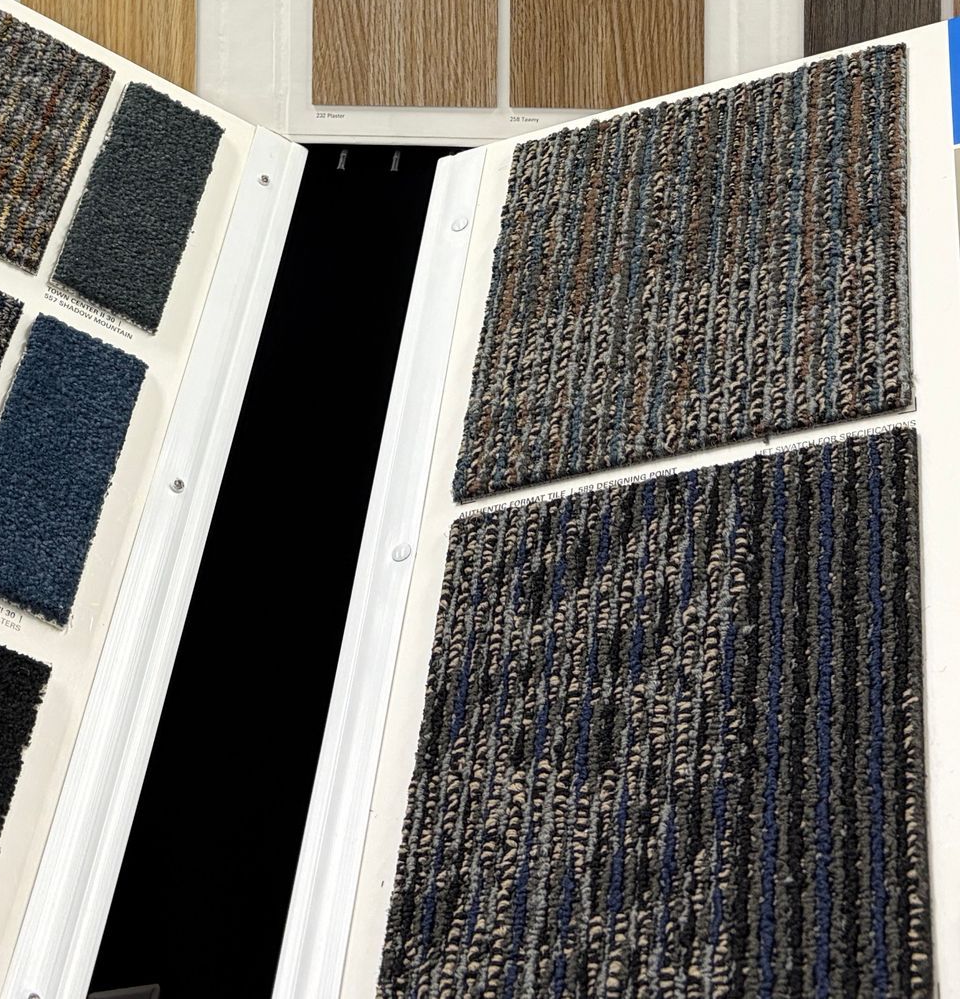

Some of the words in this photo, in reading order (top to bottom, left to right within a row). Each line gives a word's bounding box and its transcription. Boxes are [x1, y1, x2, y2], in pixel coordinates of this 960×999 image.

[44, 293, 58, 303] 557
[59, 301, 92, 320] SHADOW
[94, 318, 133, 340] MOUNTAIN
[48, 287, 70, 301] TOWN
[71, 298, 99, 316] CENTER
[106, 314, 116, 323] 30
[776, 440, 815, 452] SWATCH
[818, 436, 837, 445] FOR
[839, 420, 917, 441] SPECIFICATIONS
[459, 502, 507, 519] AUTHENTIC
[510, 495, 547, 509] FORMAT
[548, 491, 566, 501] TILE
[596, 474, 647, 490] DESIGNING
[649, 468, 678, 481] POINT
[5, 609, 16, 619] 30
